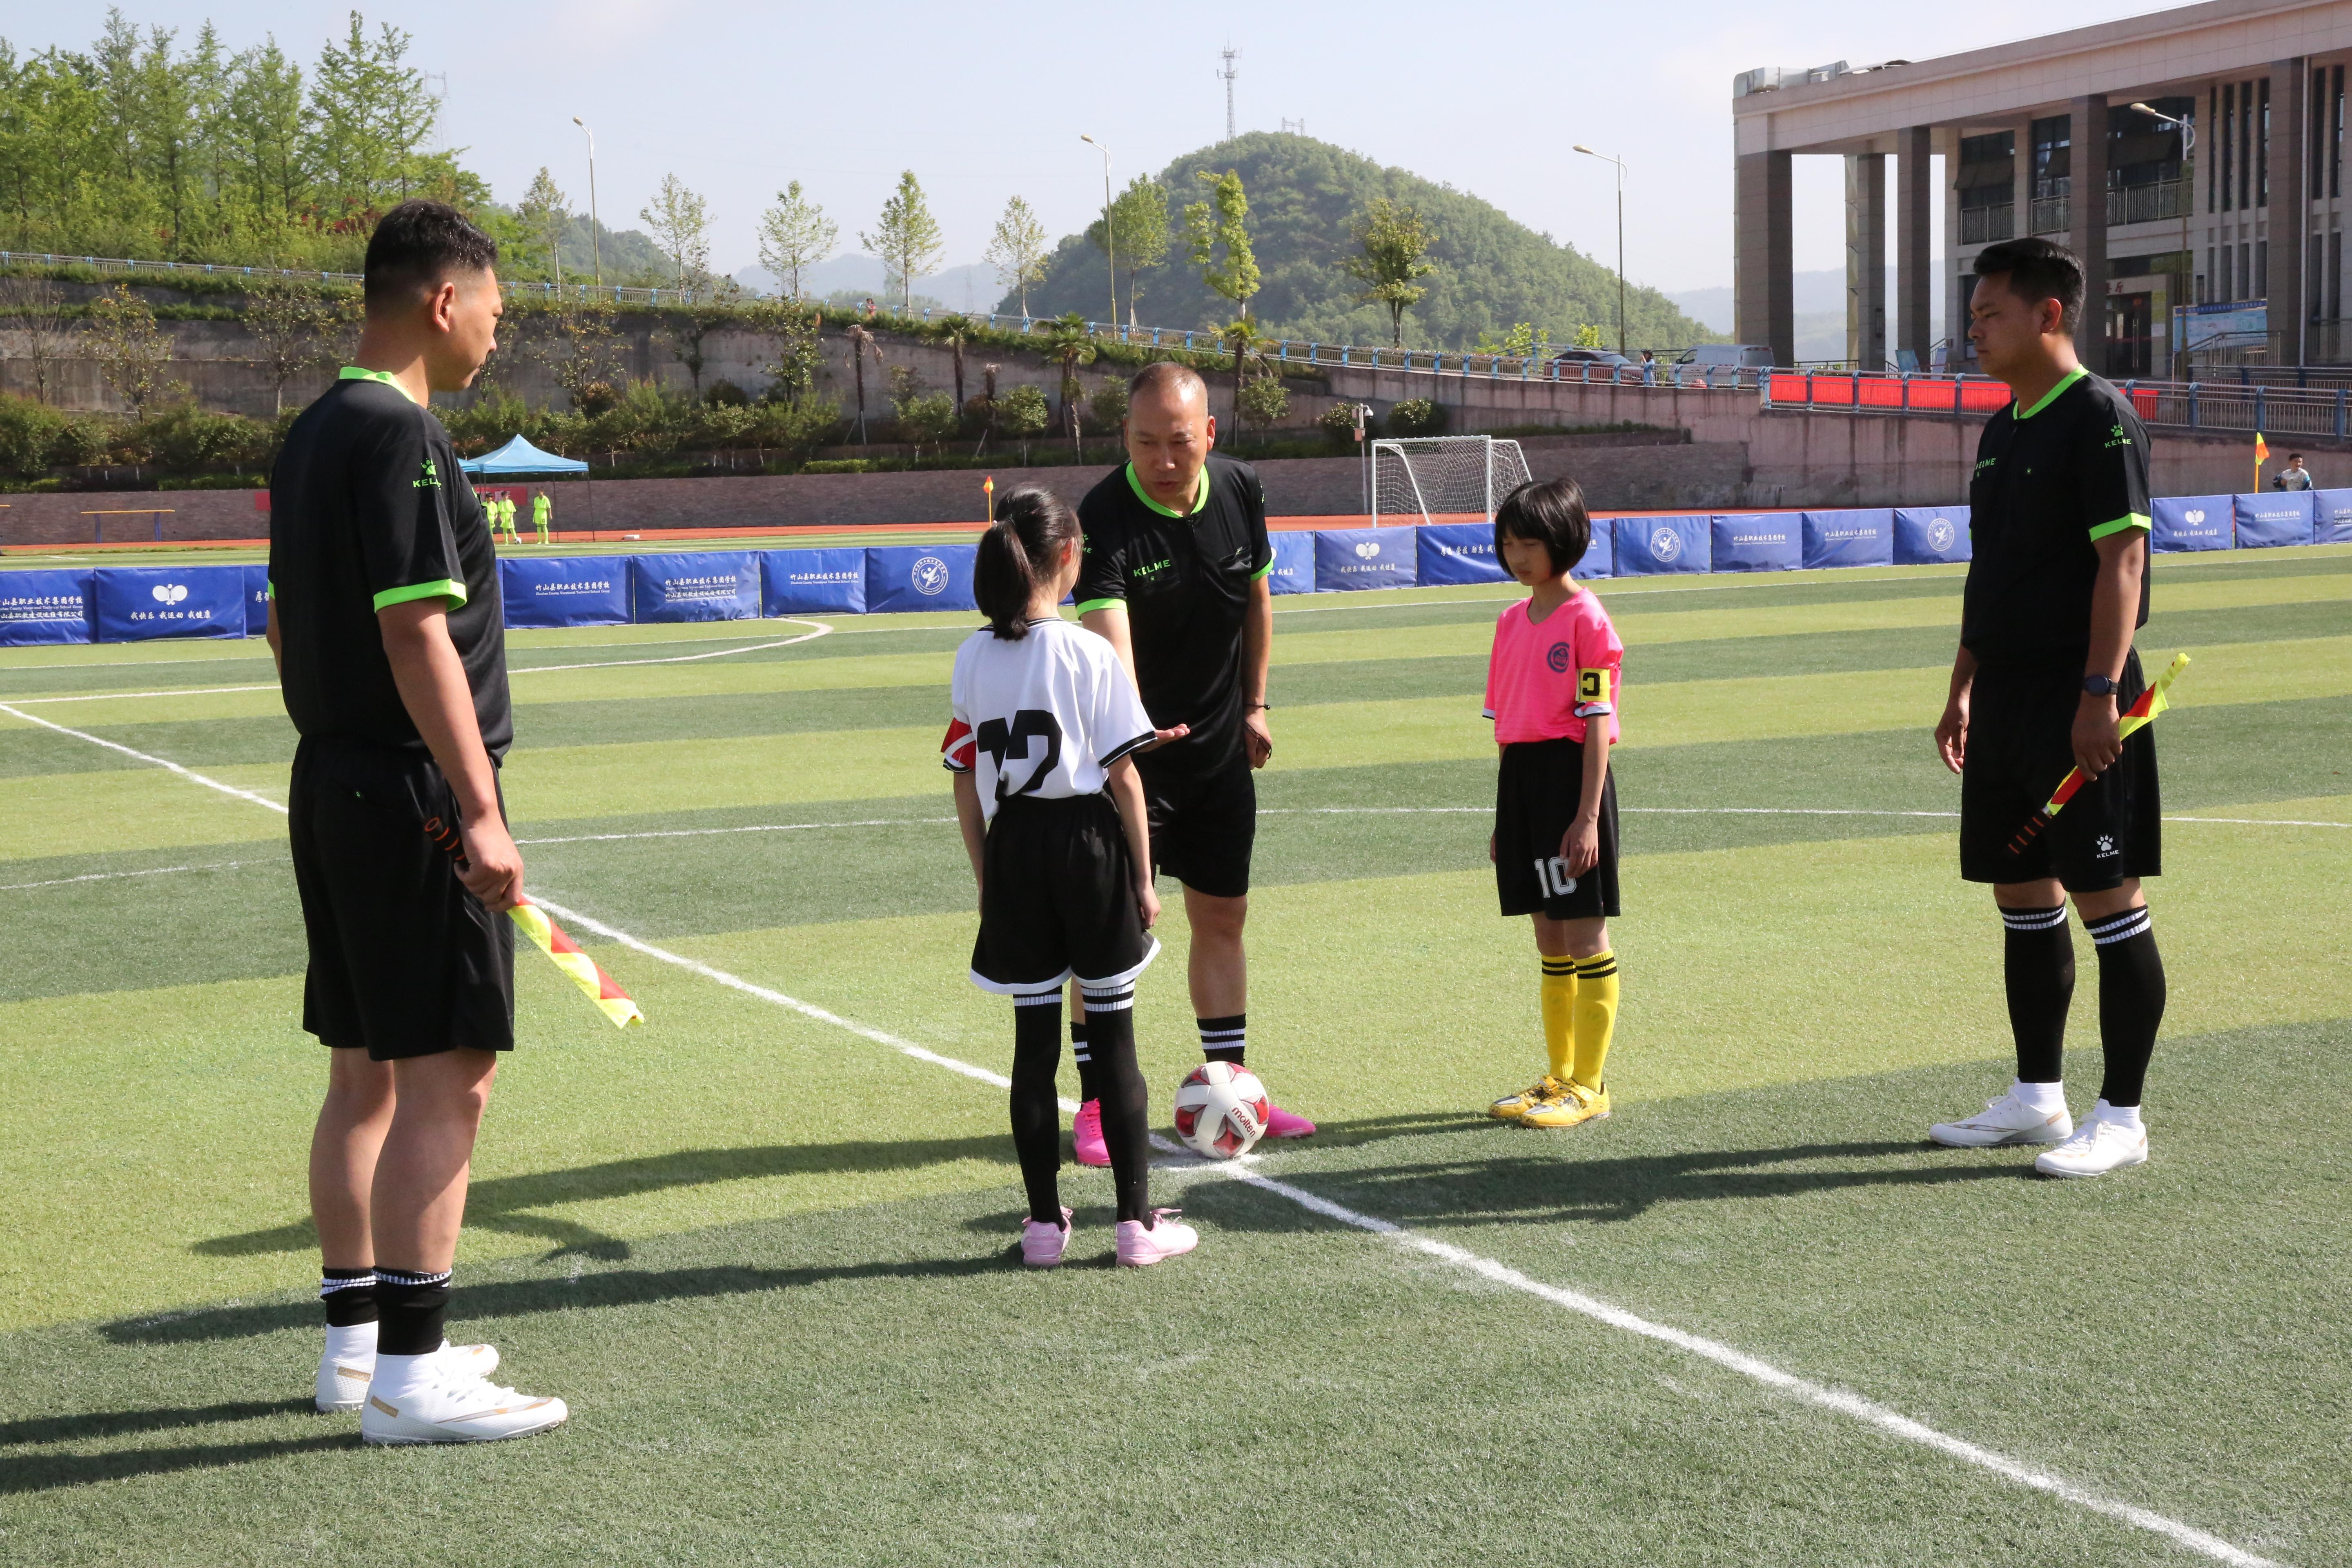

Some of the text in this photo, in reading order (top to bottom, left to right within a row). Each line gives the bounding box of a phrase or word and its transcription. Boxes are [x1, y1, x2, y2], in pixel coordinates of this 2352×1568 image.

[2105, 438, 2132, 448] KELME
[1133, 559, 1171, 577] KELME
[665, 575, 736, 586] 竹山县职业技术集团学校
[790, 572, 859, 581] 竹山县职业技术集团学校
[535, 581, 610, 591] 竹山县职业技术集团学校
[0, 596, 83, 606] 山县职业技术集团学校
[130, 609, 211, 620] 我快乐 我运动 我健康
[1582, 672, 1600, 696] C
[2096, 850, 2120, 859] KELME
[1534, 856, 1577, 898] 10
[1232, 1107, 1256, 1138] molten
